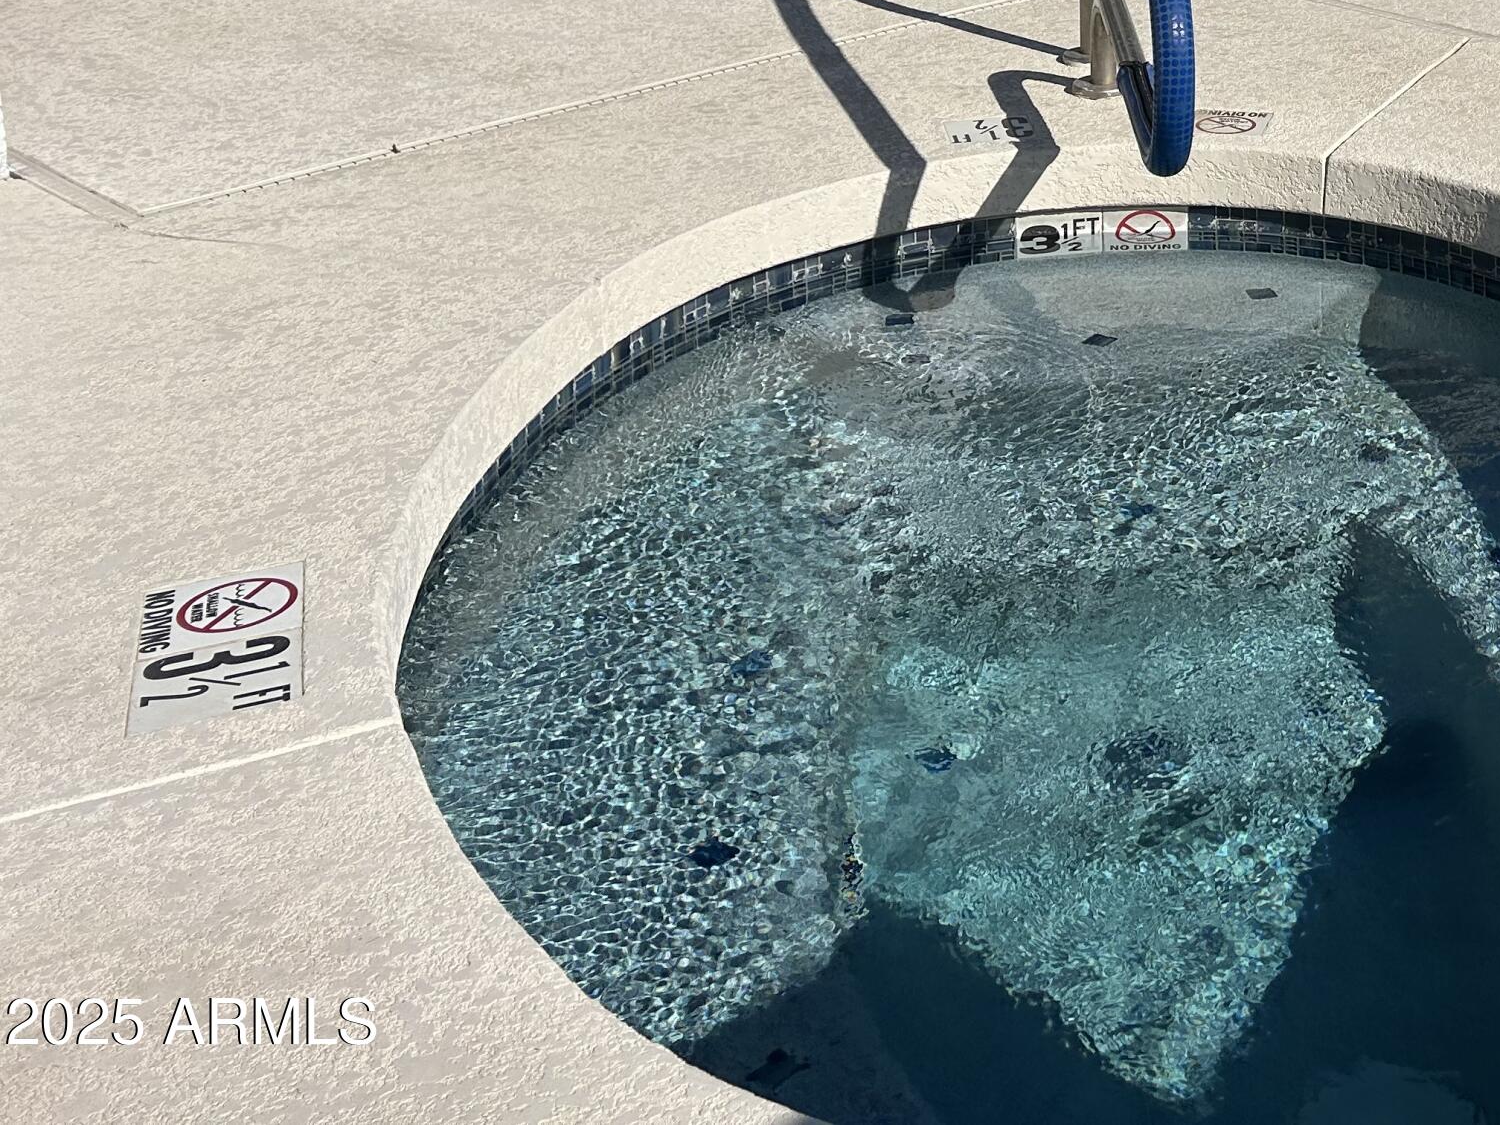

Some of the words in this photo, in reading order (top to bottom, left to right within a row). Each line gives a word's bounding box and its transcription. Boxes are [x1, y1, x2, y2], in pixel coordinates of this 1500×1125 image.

[1001, 117, 1034, 137] 3
[1019, 225, 1061, 254] 3
[1072, 217, 1101, 236] FT
[1133, 243, 1182, 251] DIVING
[144, 588, 176, 609] NO
[138, 607, 174, 654] DIVING
[143, 635, 291, 681] 3
[232, 683, 291, 710] FT
